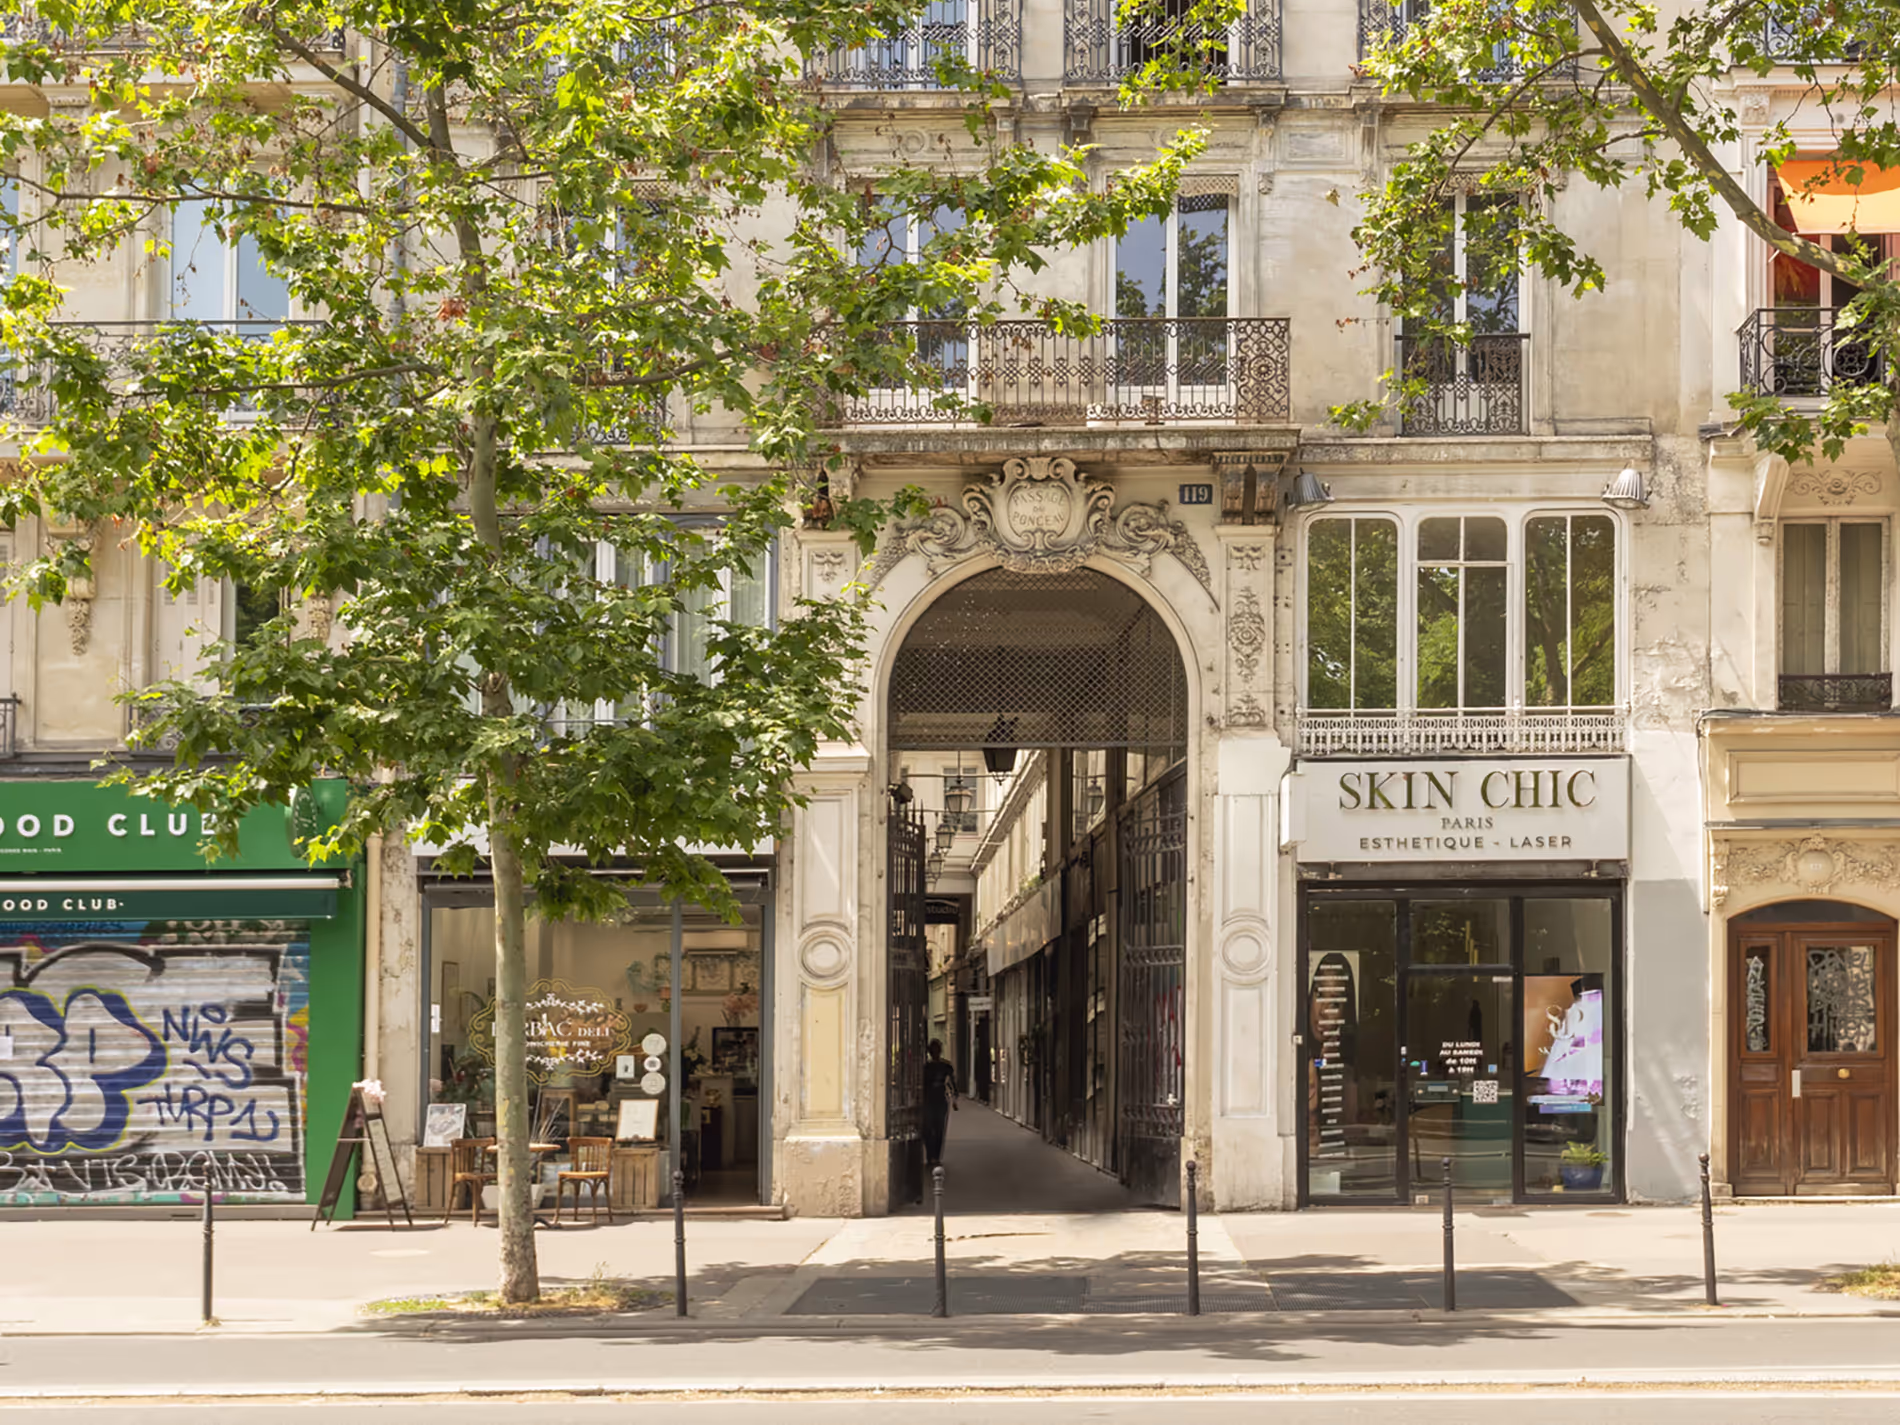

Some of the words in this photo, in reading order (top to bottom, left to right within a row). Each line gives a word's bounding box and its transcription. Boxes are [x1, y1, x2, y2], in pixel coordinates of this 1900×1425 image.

[1184, 486, 1208, 502] 119
[1339, 771, 1459, 810] SKIN
[1480, 769, 1596, 809] CHIC
[0, 813, 75, 838] OD
[1441, 817, 1494, 831] PARIS
[1359, 836, 1485, 851] ESTHETIQUE
[1510, 835, 1573, 849] LASER
[62, 898, 117, 910] CLUB
[577, 1027, 610, 1037] DELI
